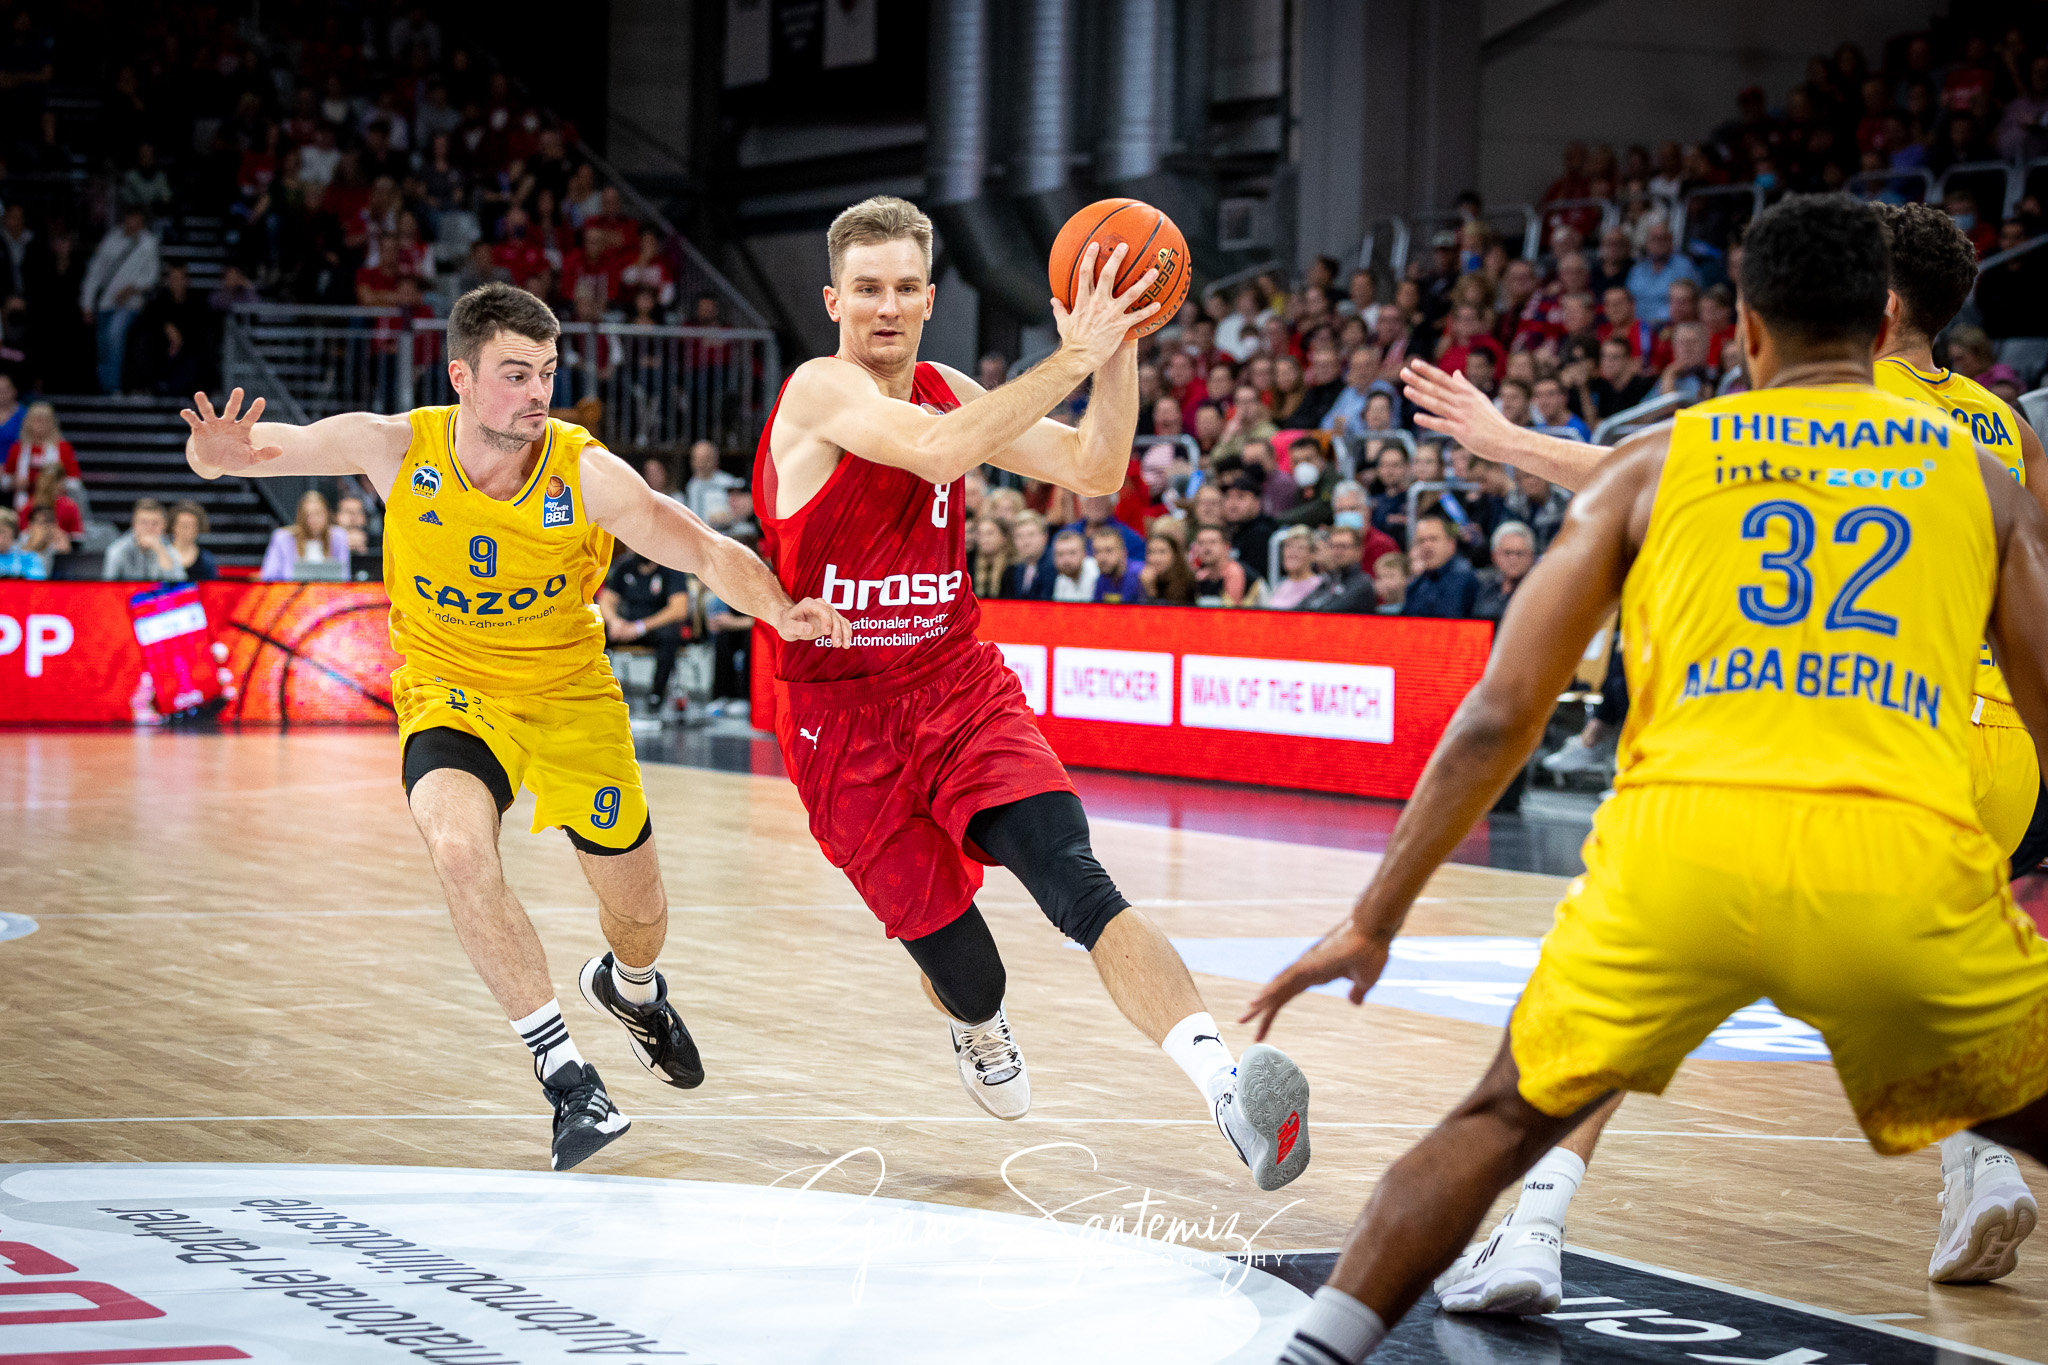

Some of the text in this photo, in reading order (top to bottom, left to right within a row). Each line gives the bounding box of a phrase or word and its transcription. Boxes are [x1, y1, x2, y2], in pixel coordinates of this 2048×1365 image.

[1711, 413, 1949, 449] THIEMANN
[414, 483, 434, 496] ALBA
[931, 482, 950, 528] 8
[545, 511, 570, 524] BBL
[469, 535, 498, 578] 9
[1738, 499, 1912, 638] 32
[413, 574, 567, 615] CAZOO
[822, 564, 962, 610] brose
[1061, 667, 1159, 701] LIVETICKER
[1191, 675, 1381, 719] MAN OF THE MATCH
[1681, 647, 1940, 728] ALBA BERLIN
[590, 786, 621, 830] 9
[96, 1207, 288, 1264] Partner
[231, 1199, 689, 1355] Automobilindustrie
